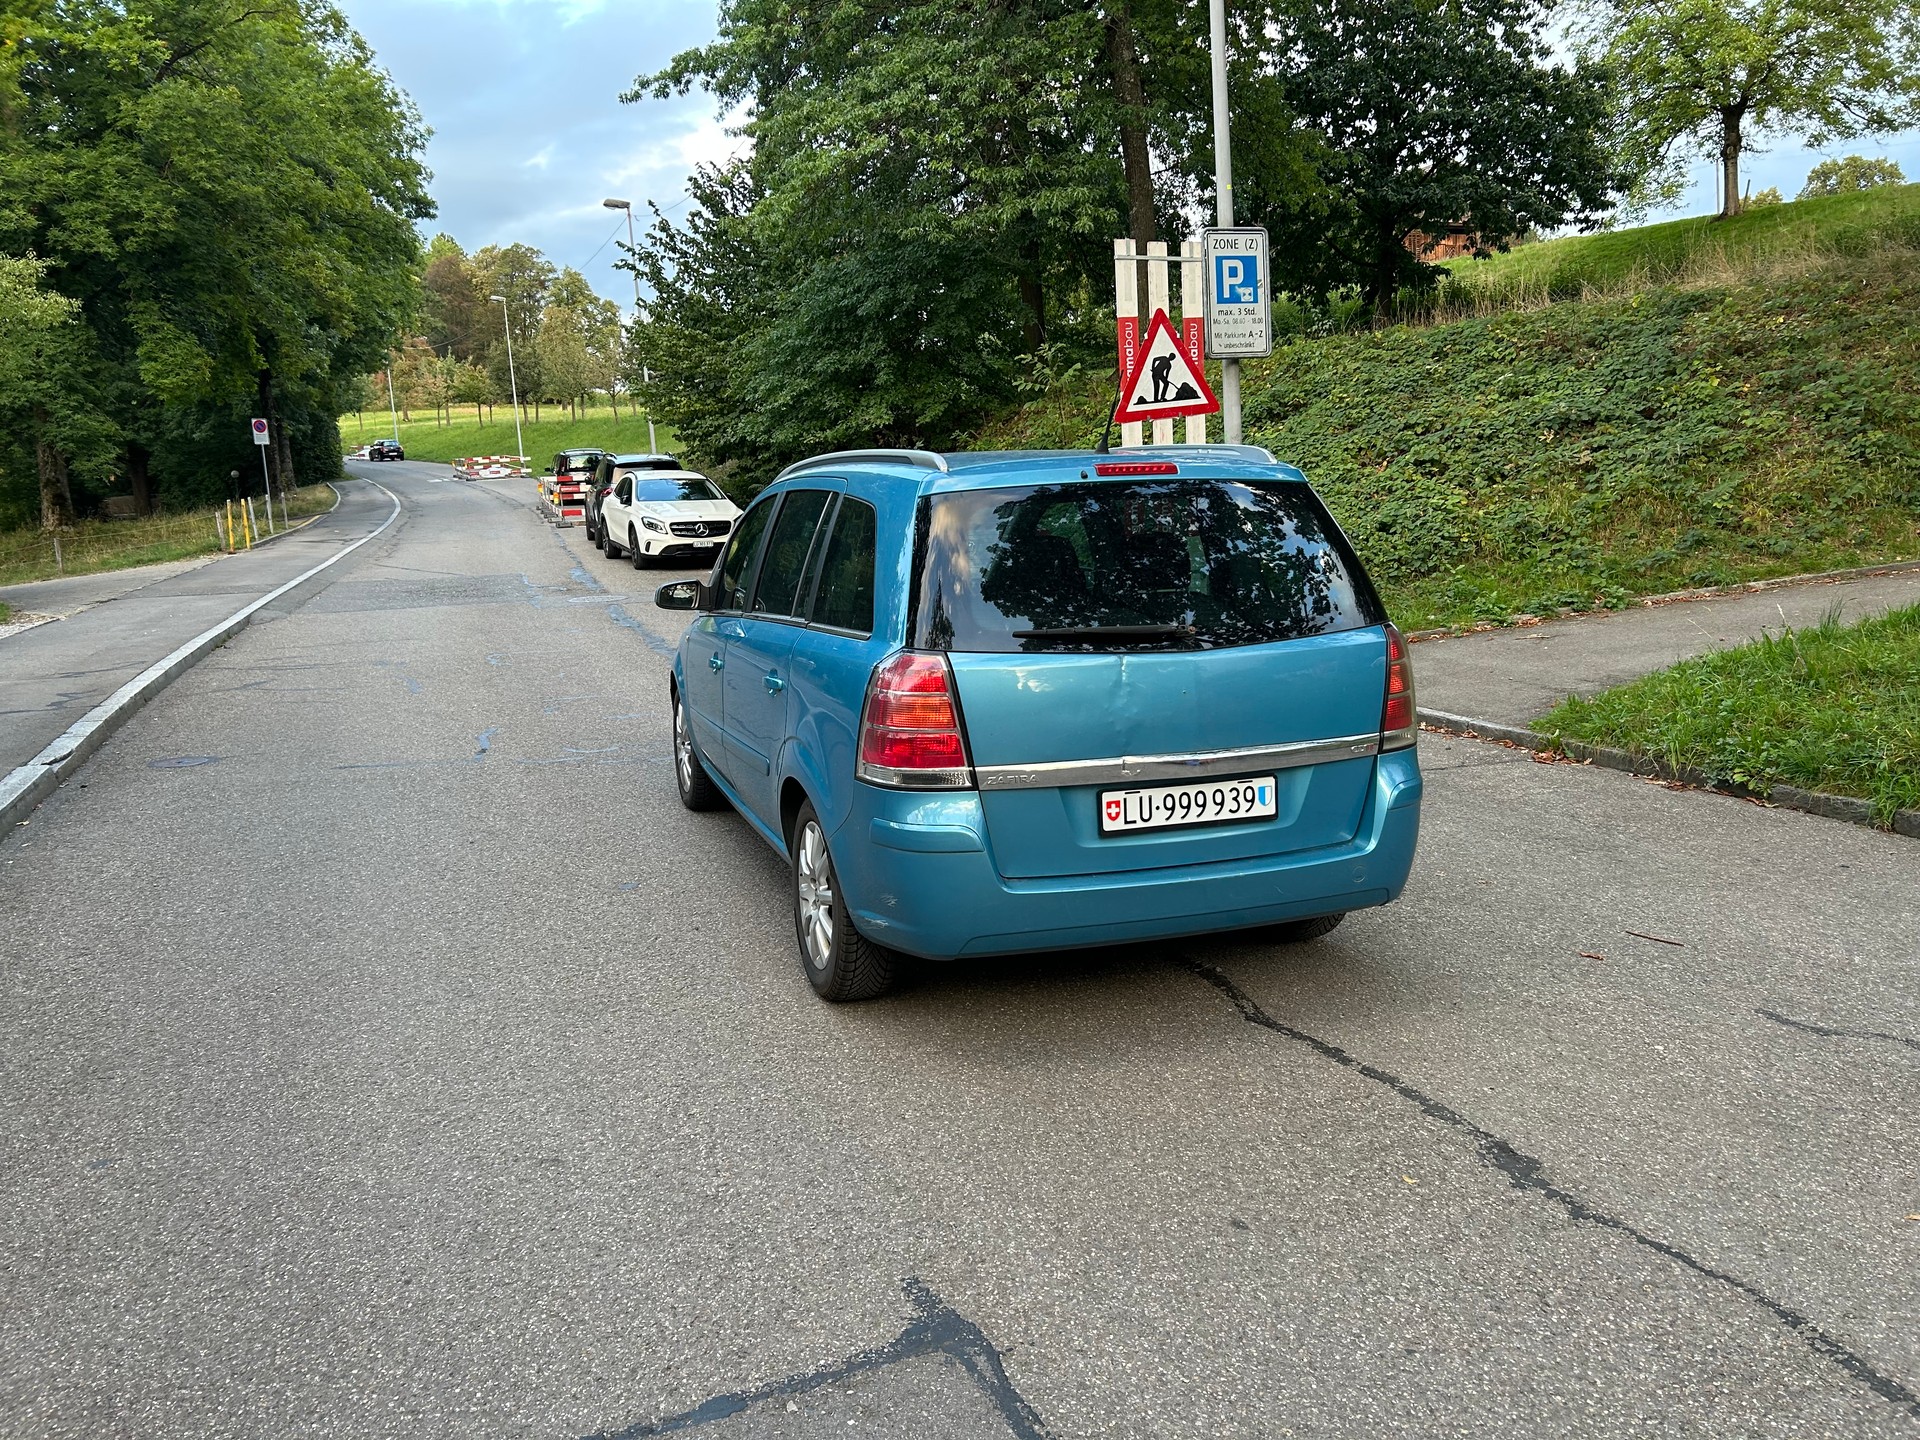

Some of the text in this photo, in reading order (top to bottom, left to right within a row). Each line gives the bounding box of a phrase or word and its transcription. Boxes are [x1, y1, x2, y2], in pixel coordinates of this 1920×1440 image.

[1213, 238, 1258, 251] ZONE (Z)
[1222, 259, 1244, 299] P
[1238, 308, 1242, 316] 3
[1243, 307, 1257, 316] Std.
[1124, 322, 1134, 381] amabau
[987, 774, 1039, 785] ZAFIRA
